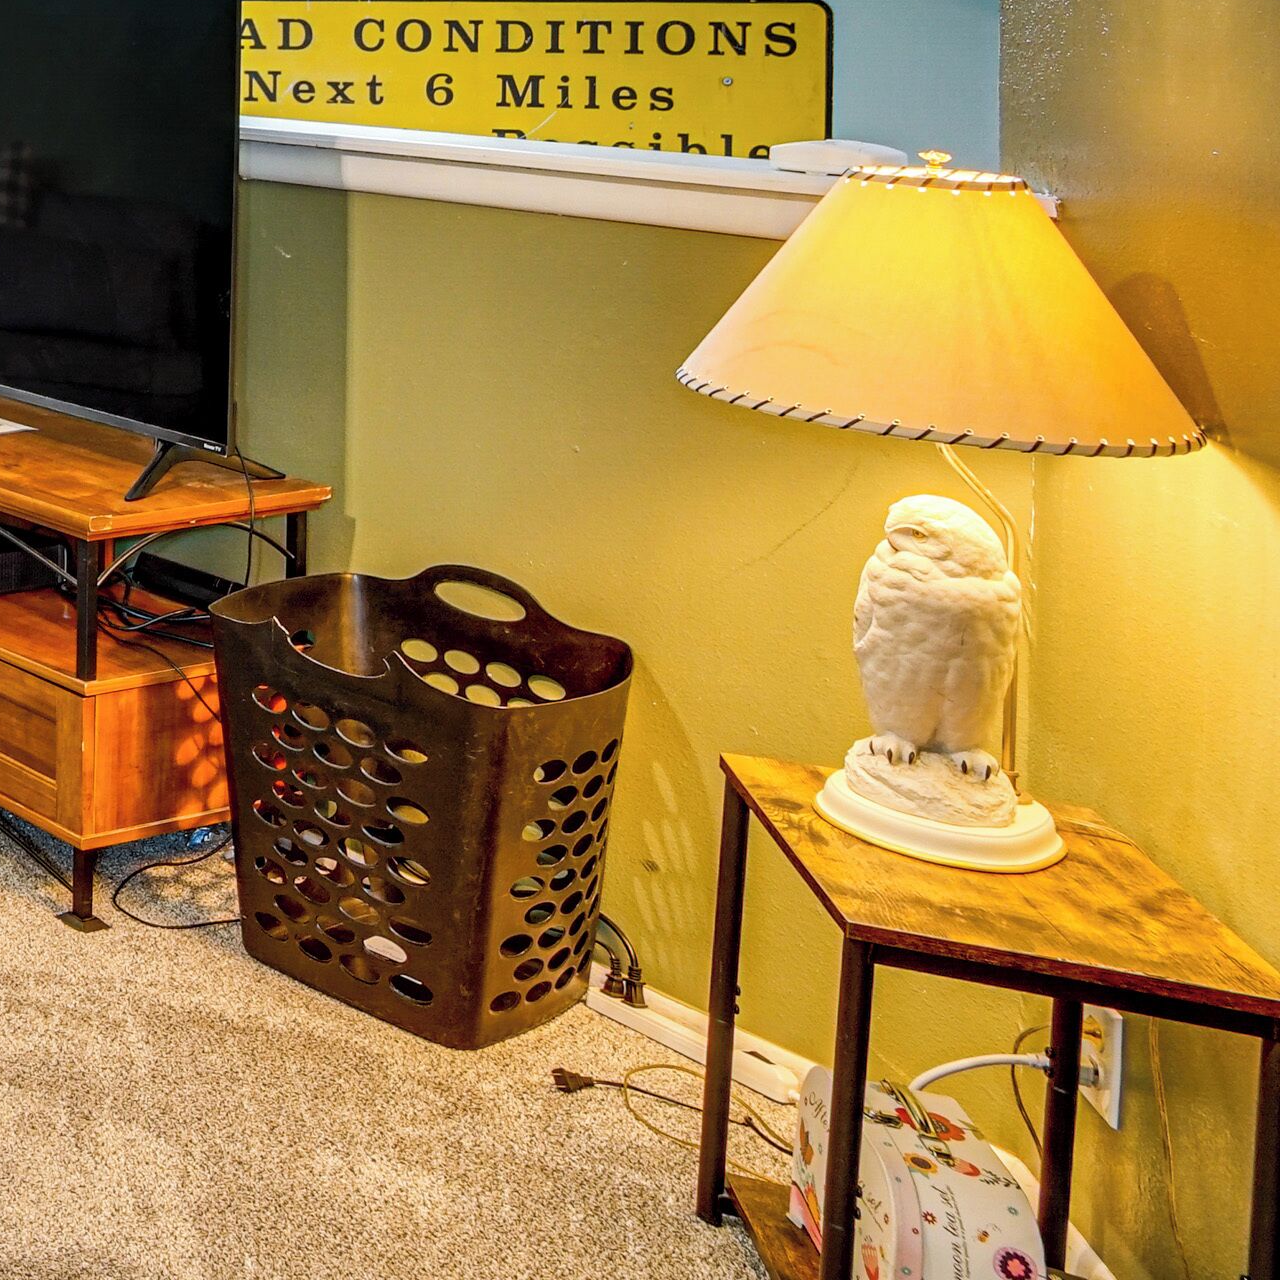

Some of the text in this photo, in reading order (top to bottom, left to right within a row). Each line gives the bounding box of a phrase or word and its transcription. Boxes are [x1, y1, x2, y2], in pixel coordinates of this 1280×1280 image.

[354, 18, 798, 57] CONDITIONS
[243, 70, 674, 111] Next 6 Miles
[809, 1091, 830, 1132] Afte
